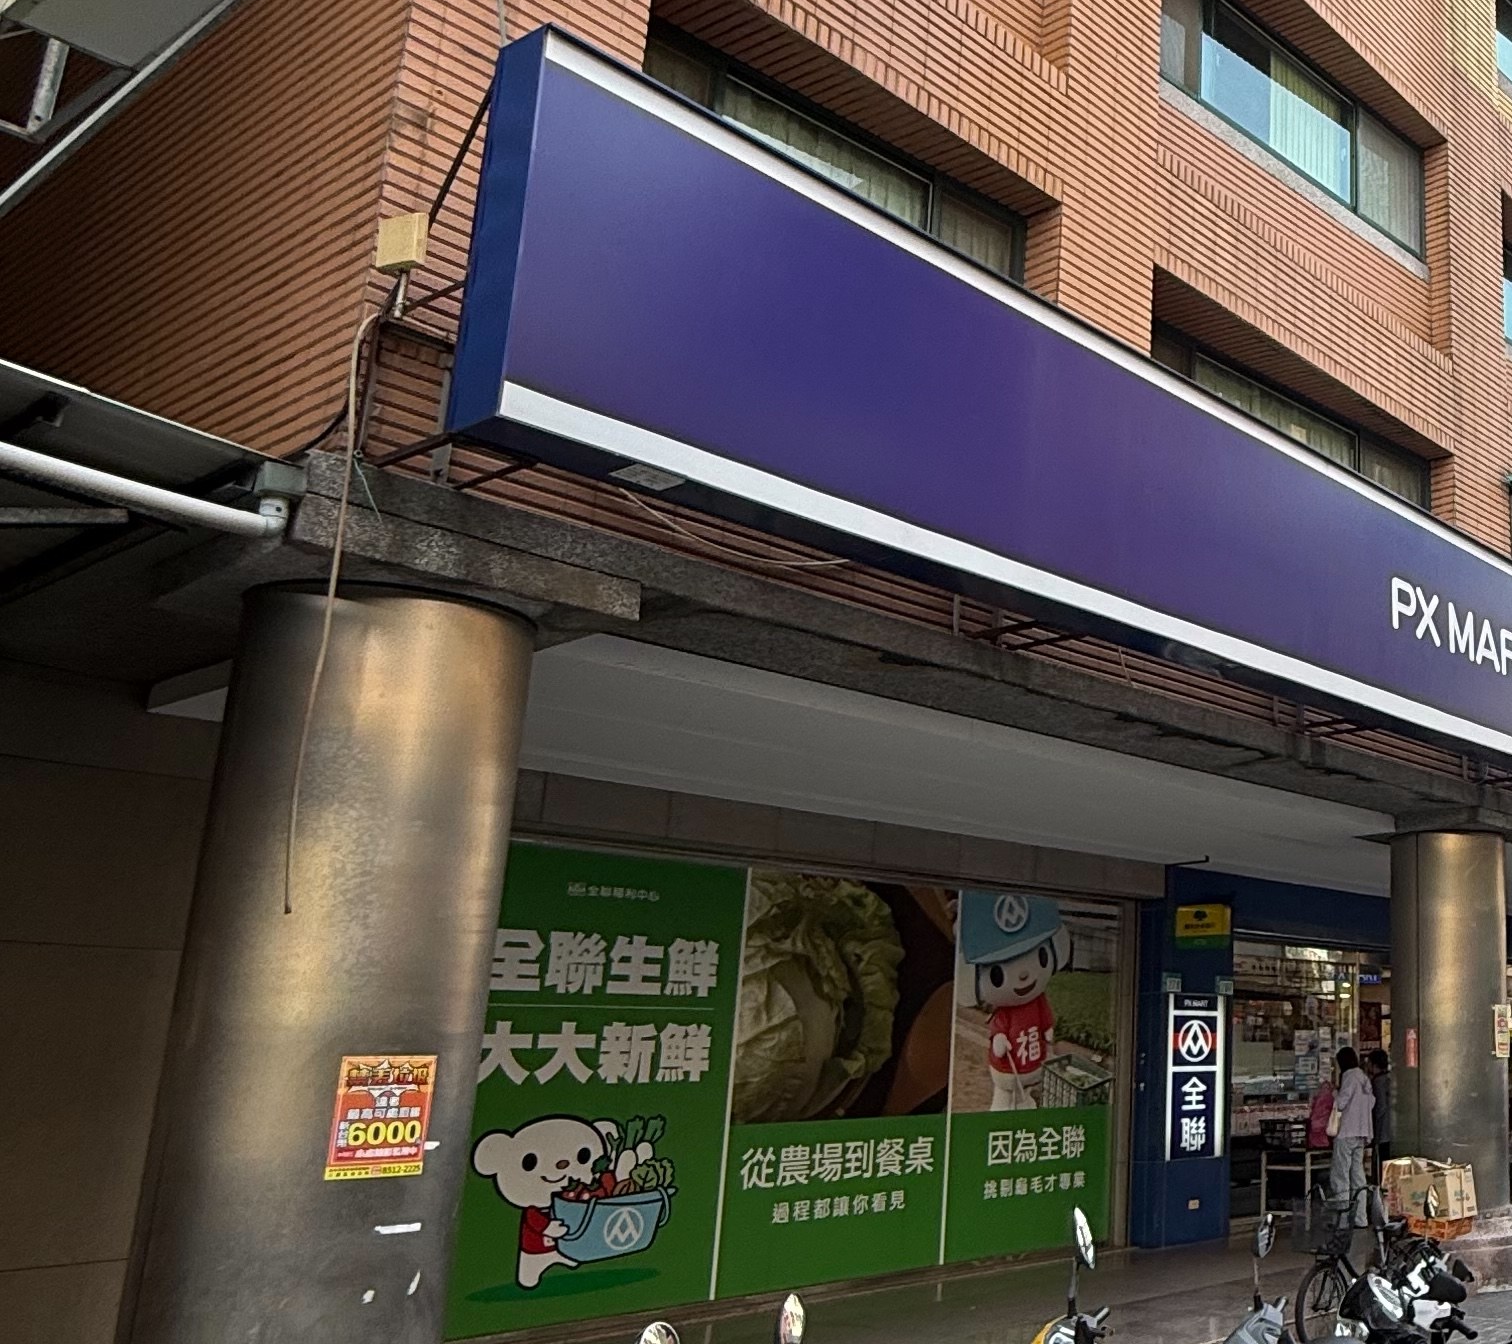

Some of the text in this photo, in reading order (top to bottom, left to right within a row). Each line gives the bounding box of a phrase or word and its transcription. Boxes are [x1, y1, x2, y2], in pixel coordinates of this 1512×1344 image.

[1390, 576, 1442, 649] PX
[489, 927, 720, 997] 全聯生鮮
[477, 1020, 712, 1086] 大大新鮮
[1016, 1026, 1042, 1065] 福
[348, 1120, 422, 1146] 6000
[1179, 1076, 1208, 1152] 全聯
[740, 1136, 935, 1190] 從農場到餐桌
[987, 1124, 1086, 1167] 因為全聯
